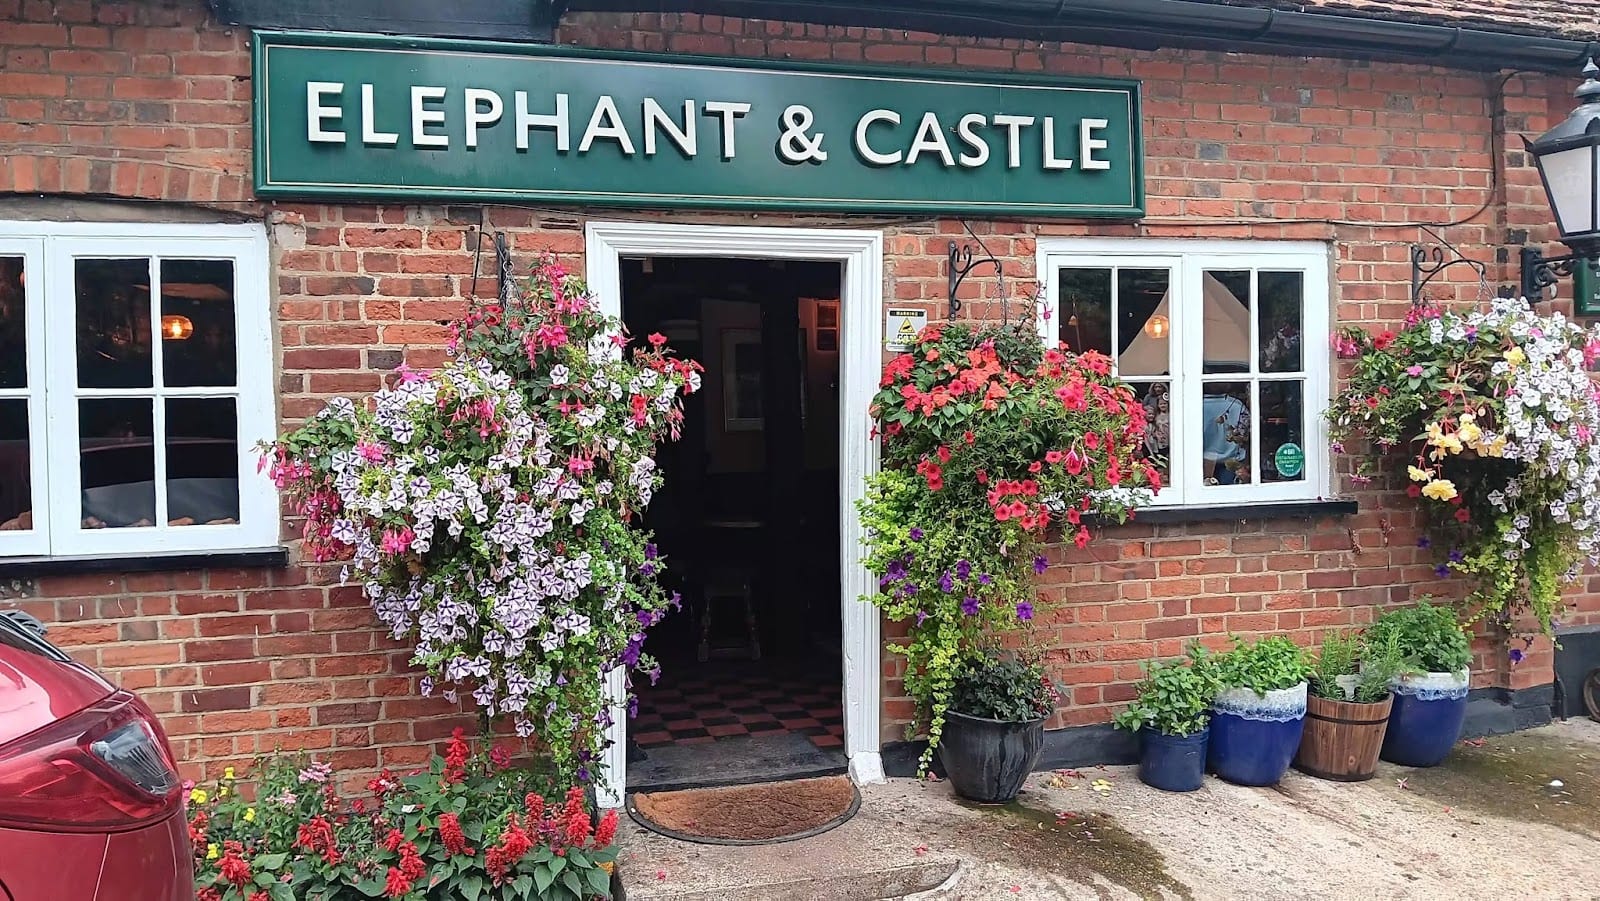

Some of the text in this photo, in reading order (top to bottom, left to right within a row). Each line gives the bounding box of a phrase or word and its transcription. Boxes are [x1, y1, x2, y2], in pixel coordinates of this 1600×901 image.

[307, 82, 1110, 170] ELEPHANT & CASTLE
